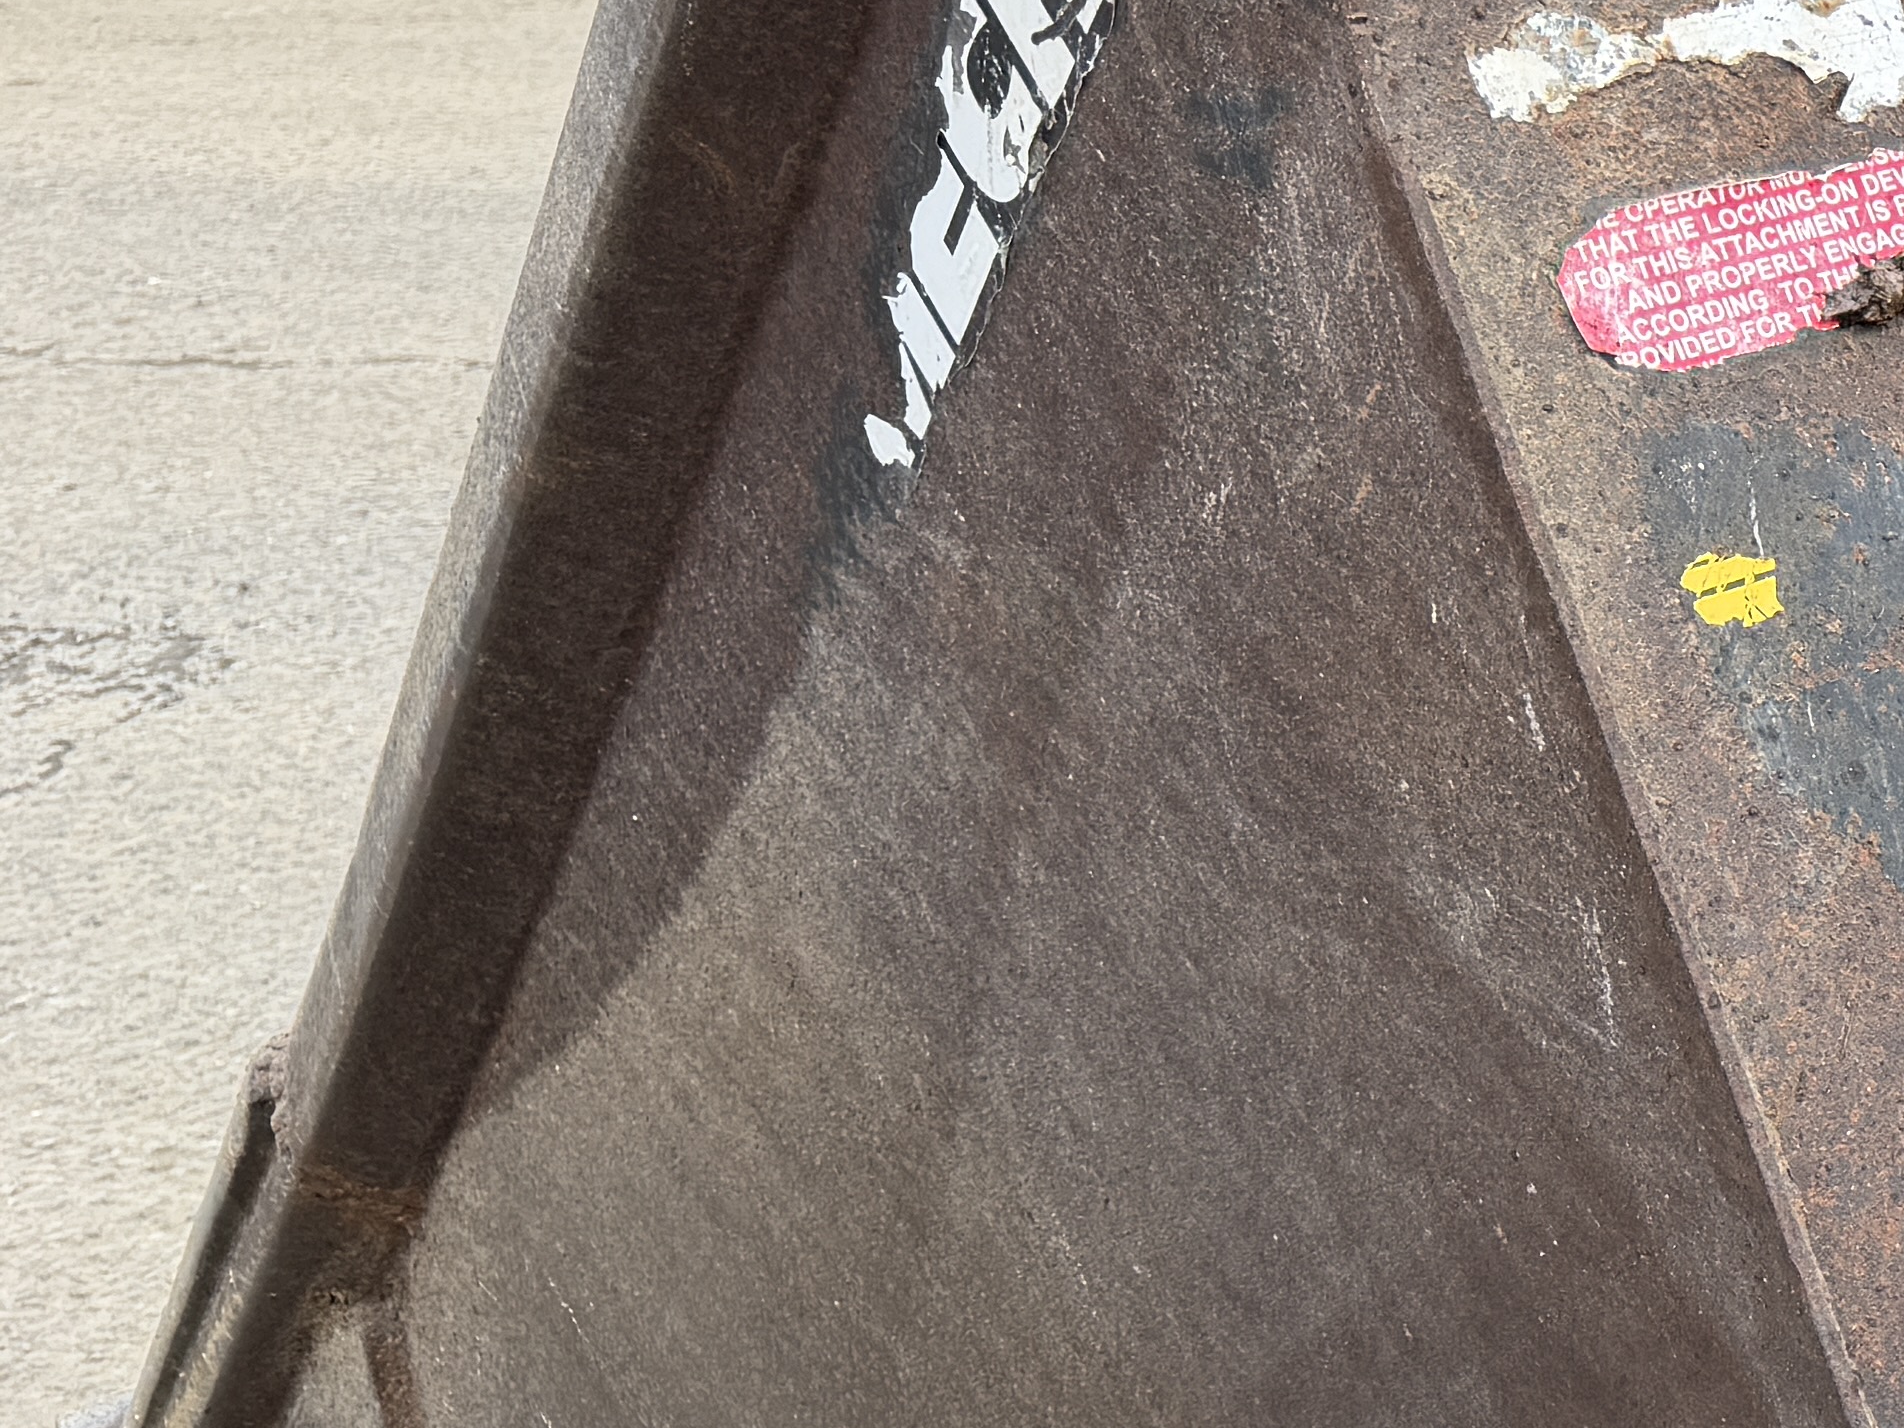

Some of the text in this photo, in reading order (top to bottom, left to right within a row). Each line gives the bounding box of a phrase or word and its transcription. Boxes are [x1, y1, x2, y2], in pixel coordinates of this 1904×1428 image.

[1574, 228, 1638, 264] THAT
[1643, 215, 1700, 250] THE
[1701, 178, 1860, 235] LOCKING-ON
[1624, 180, 1765, 222] OPERATOR
[1573, 261, 1633, 297] FOR
[1632, 247, 1694, 281] THIS
[1698, 205, 1861, 267] ATTACHMENT
[1864, 198, 1891, 225] IS
[1627, 280, 1682, 315] AND
[1684, 244, 1818, 299] PROPERLY
[1614, 327, 1736, 369] ROVIDED
[1739, 310, 1798, 345] FOR
[1618, 288, 1770, 345] ACCORDING
[1777, 275, 1815, 304] TO
